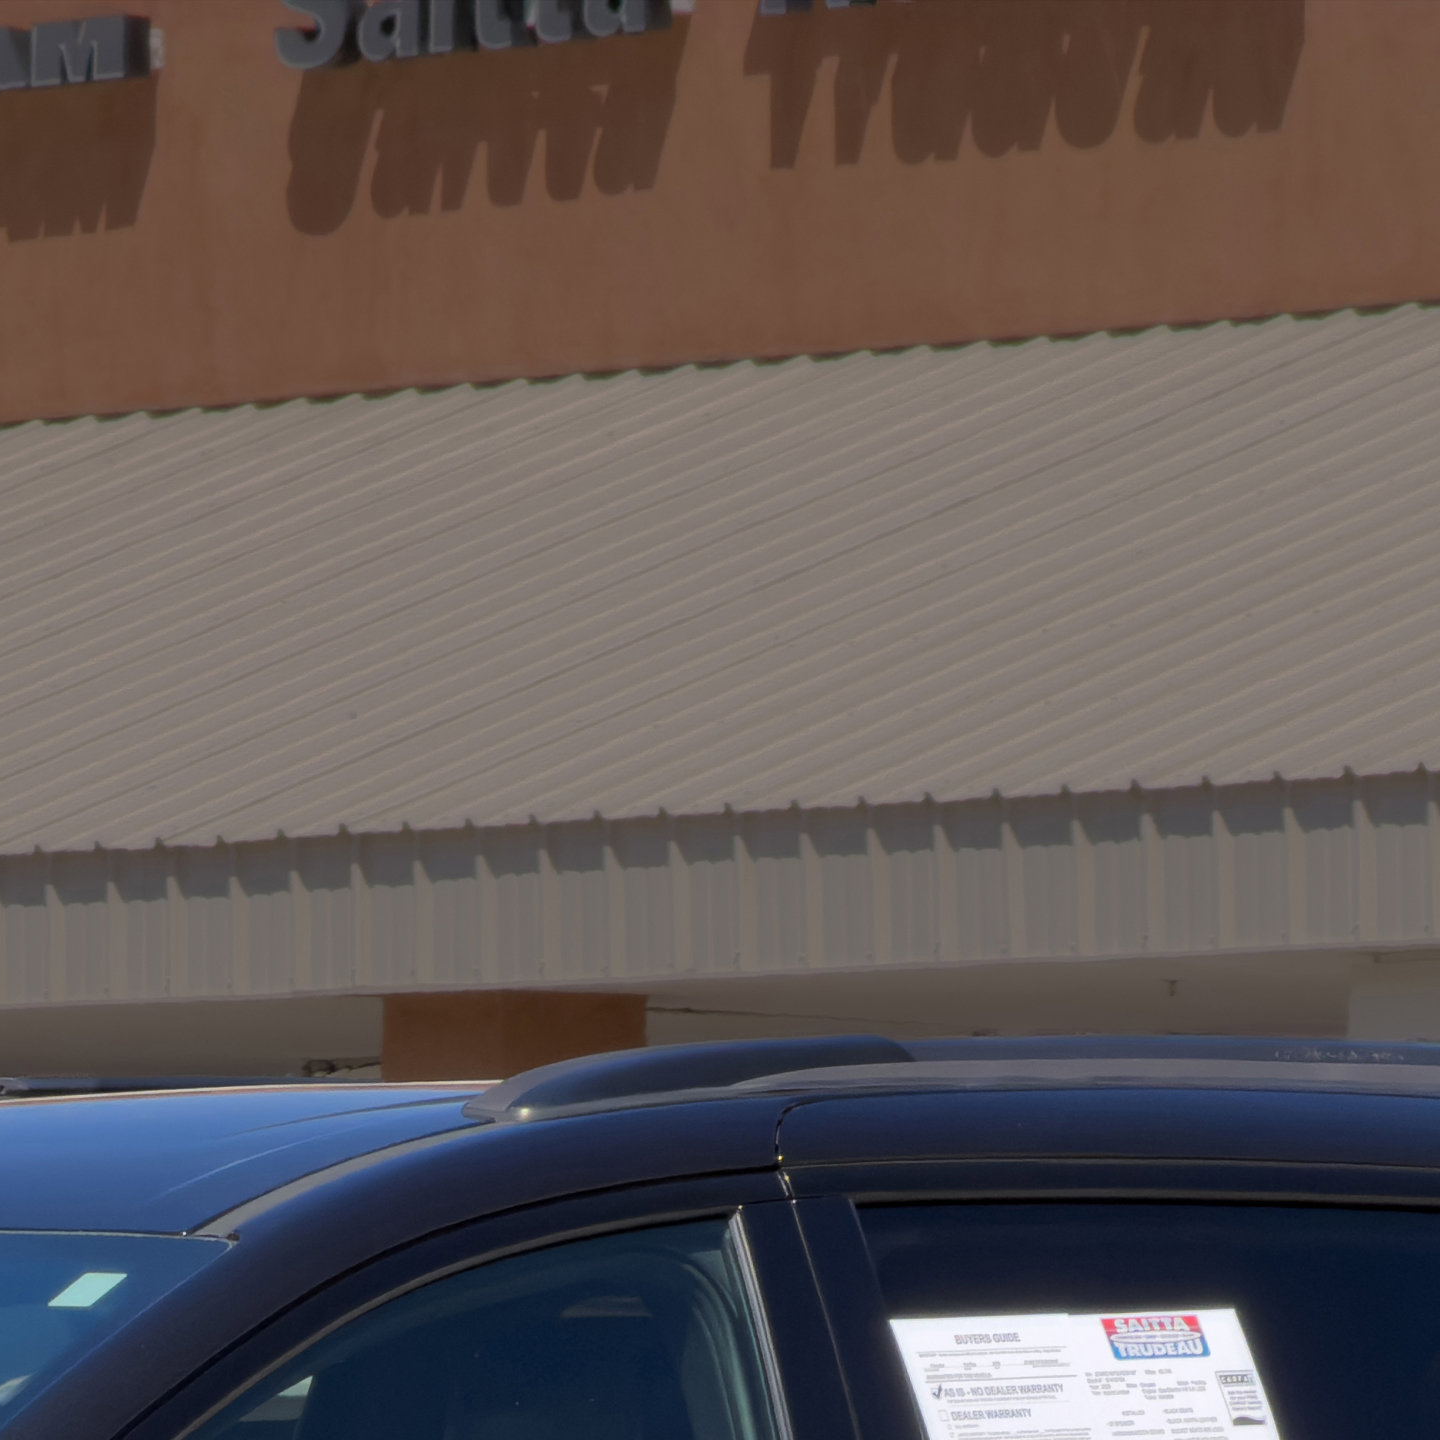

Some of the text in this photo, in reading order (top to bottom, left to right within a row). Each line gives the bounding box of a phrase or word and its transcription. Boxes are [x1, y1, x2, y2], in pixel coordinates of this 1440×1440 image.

[1114, 1317, 1190, 1333] SAITTA
[954, 1332, 1021, 1345] BUYERS GUIDE
[1114, 1339, 1203, 1357] TRUDEAU
[985, 1385, 1018, 1396] DEALER
[1019, 1383, 1064, 1394] WARRANTY
[951, 1408, 1032, 1421] DEALER WARRANTY
